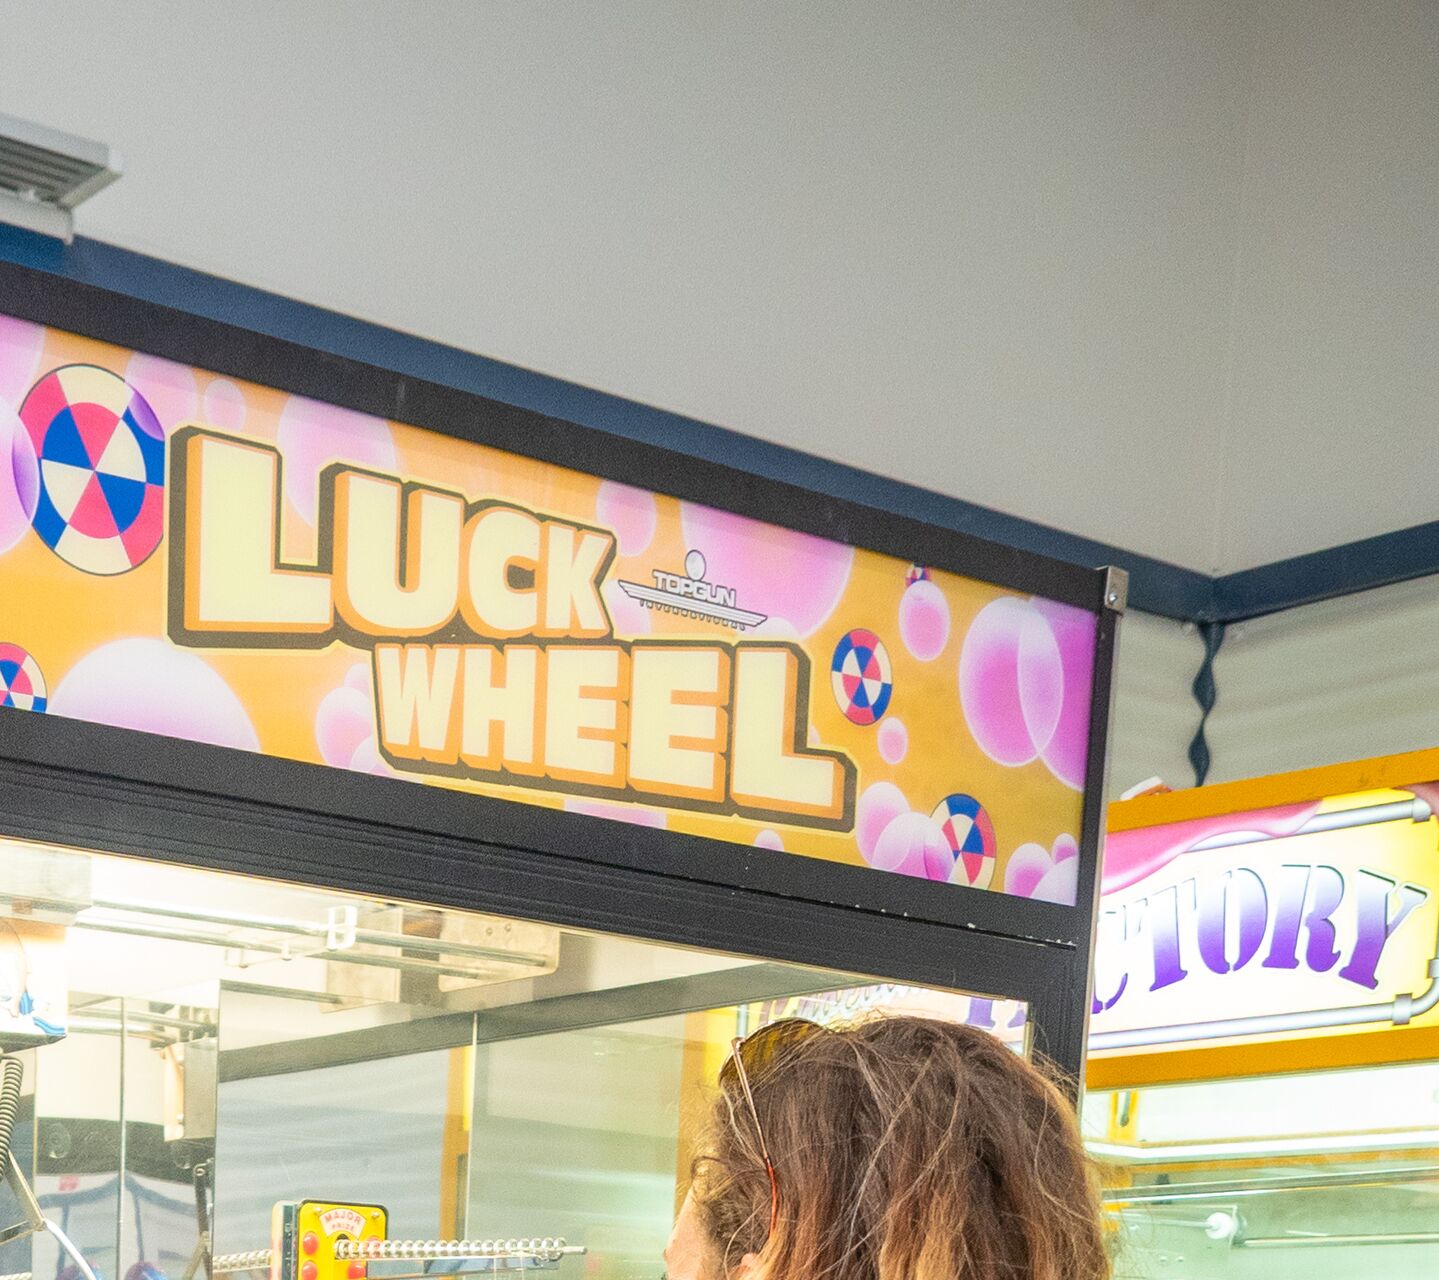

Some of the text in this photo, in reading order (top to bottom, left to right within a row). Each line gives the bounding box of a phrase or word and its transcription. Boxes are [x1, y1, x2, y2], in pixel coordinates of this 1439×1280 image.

[167, 426, 618, 648] LUCK
[652, 569, 737, 608] TOPGUN
[371, 641, 858, 832] WHEEL
[325, 1210, 362, 1224] MAJOR
